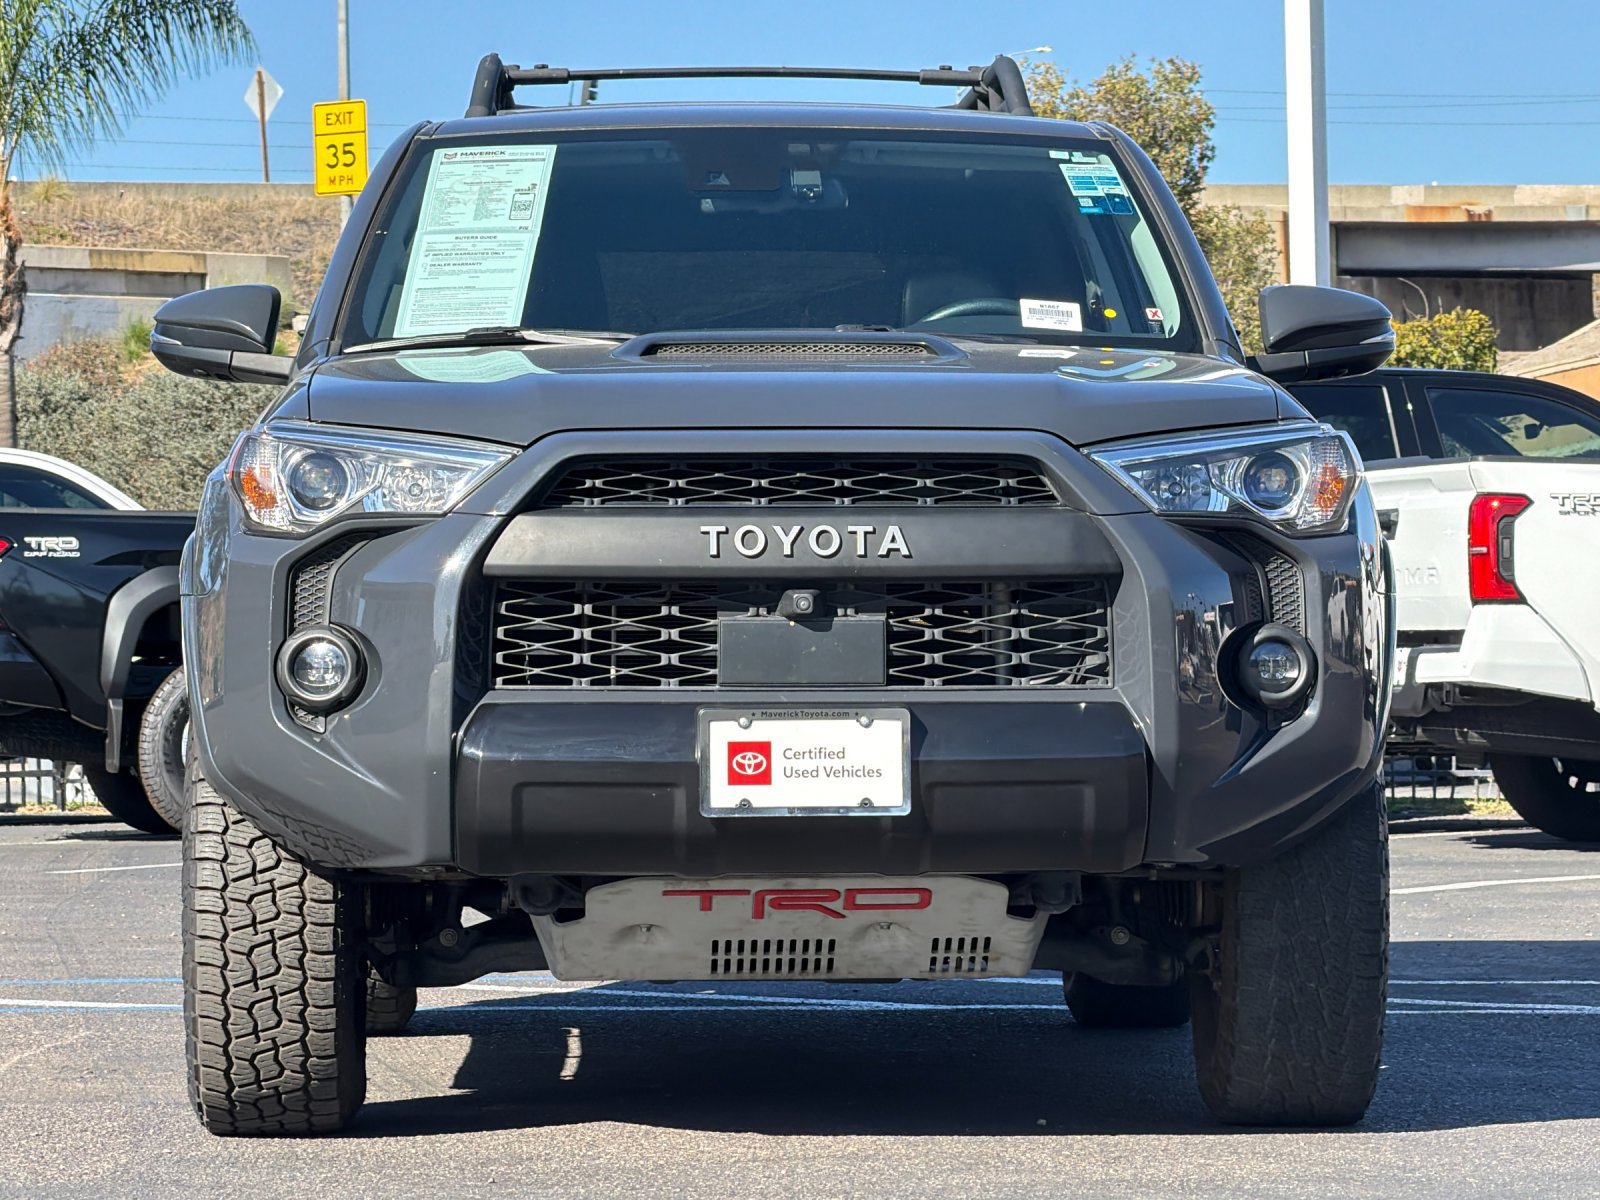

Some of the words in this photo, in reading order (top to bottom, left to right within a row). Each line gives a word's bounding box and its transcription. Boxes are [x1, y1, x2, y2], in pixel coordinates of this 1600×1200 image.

[325, 111, 354, 126] EXIT
[326, 142, 356, 169] 35
[329, 174, 354, 186] MPH
[24, 537, 79, 551] TRD
[700, 525, 913, 558] TOYOTA
[783, 747, 845, 760] Certified
[783, 766, 819, 778] Used
[823, 766, 882, 778] Vehicles
[662, 887, 932, 920] TRD
